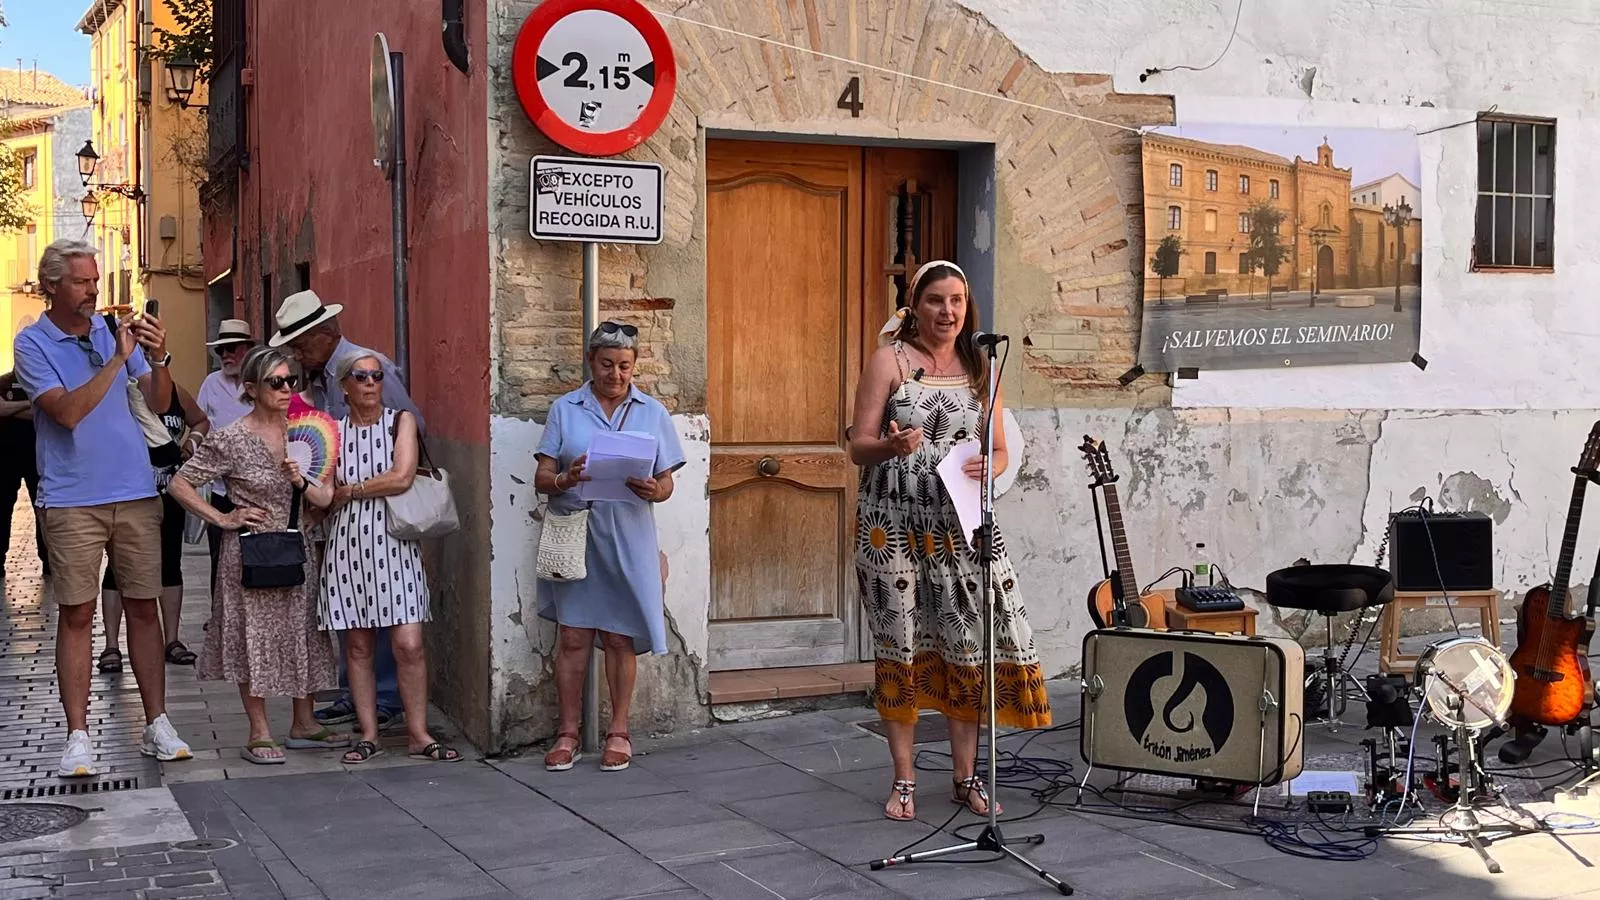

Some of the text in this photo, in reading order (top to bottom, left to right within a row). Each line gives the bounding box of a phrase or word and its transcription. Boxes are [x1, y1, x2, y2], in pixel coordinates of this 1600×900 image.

[617, 52, 631, 63] m
[837, 76, 864, 118] 4
[561, 172, 634, 190] EXCEPTO
[554, 189, 643, 210] VEHÍCULOS
[539, 211, 655, 230] RECOGIDA R.U.
[1162, 323, 1394, 354] ¡SALVEMOS EL SEMINARIO!
